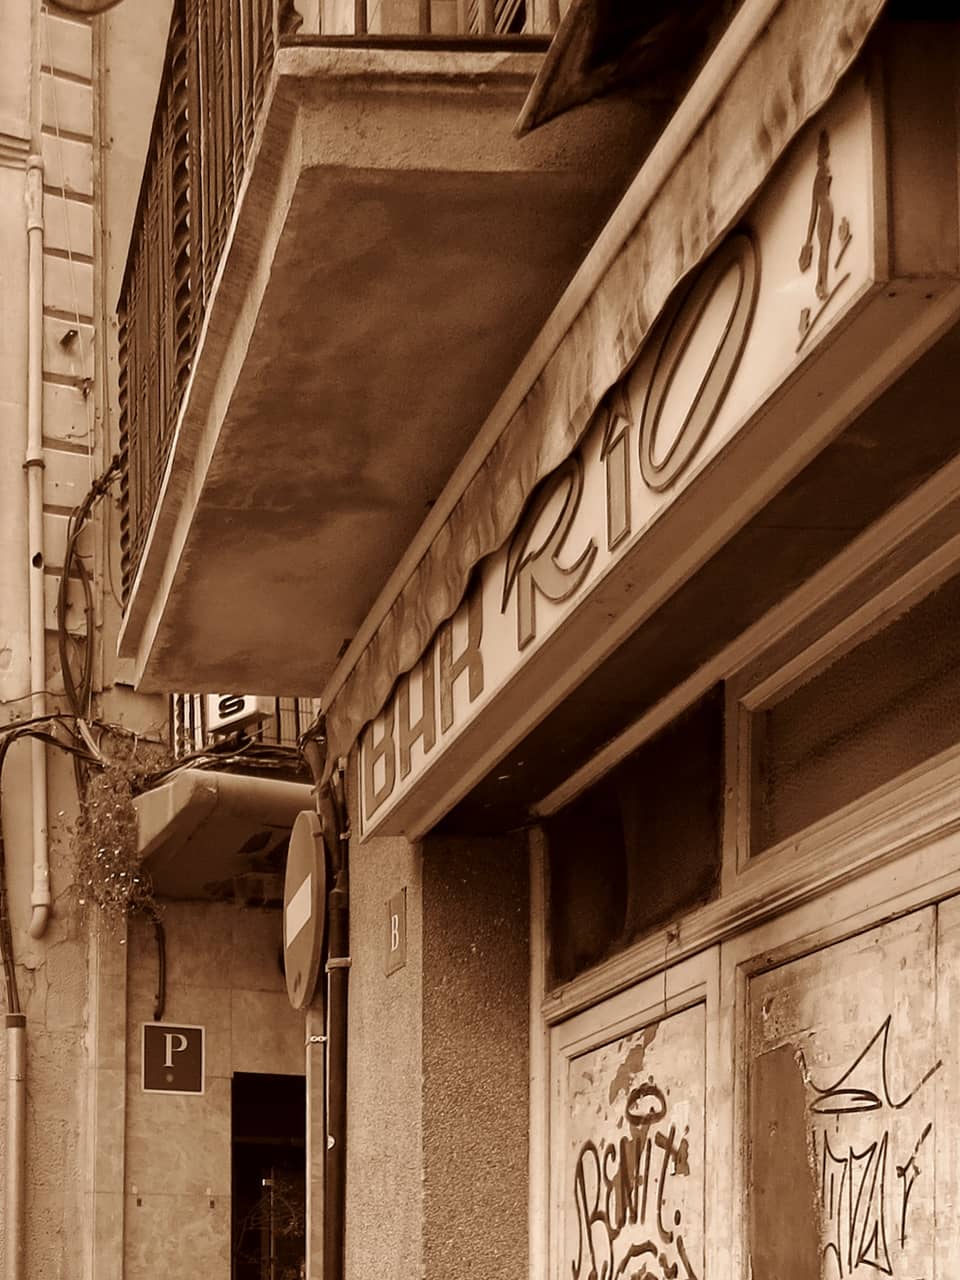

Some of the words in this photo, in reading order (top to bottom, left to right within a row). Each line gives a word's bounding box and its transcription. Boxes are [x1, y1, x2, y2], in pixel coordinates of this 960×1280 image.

[362, 572, 485, 821] BAR
[391, 914, 400, 952] B
[163, 1033, 189, 1068] P
